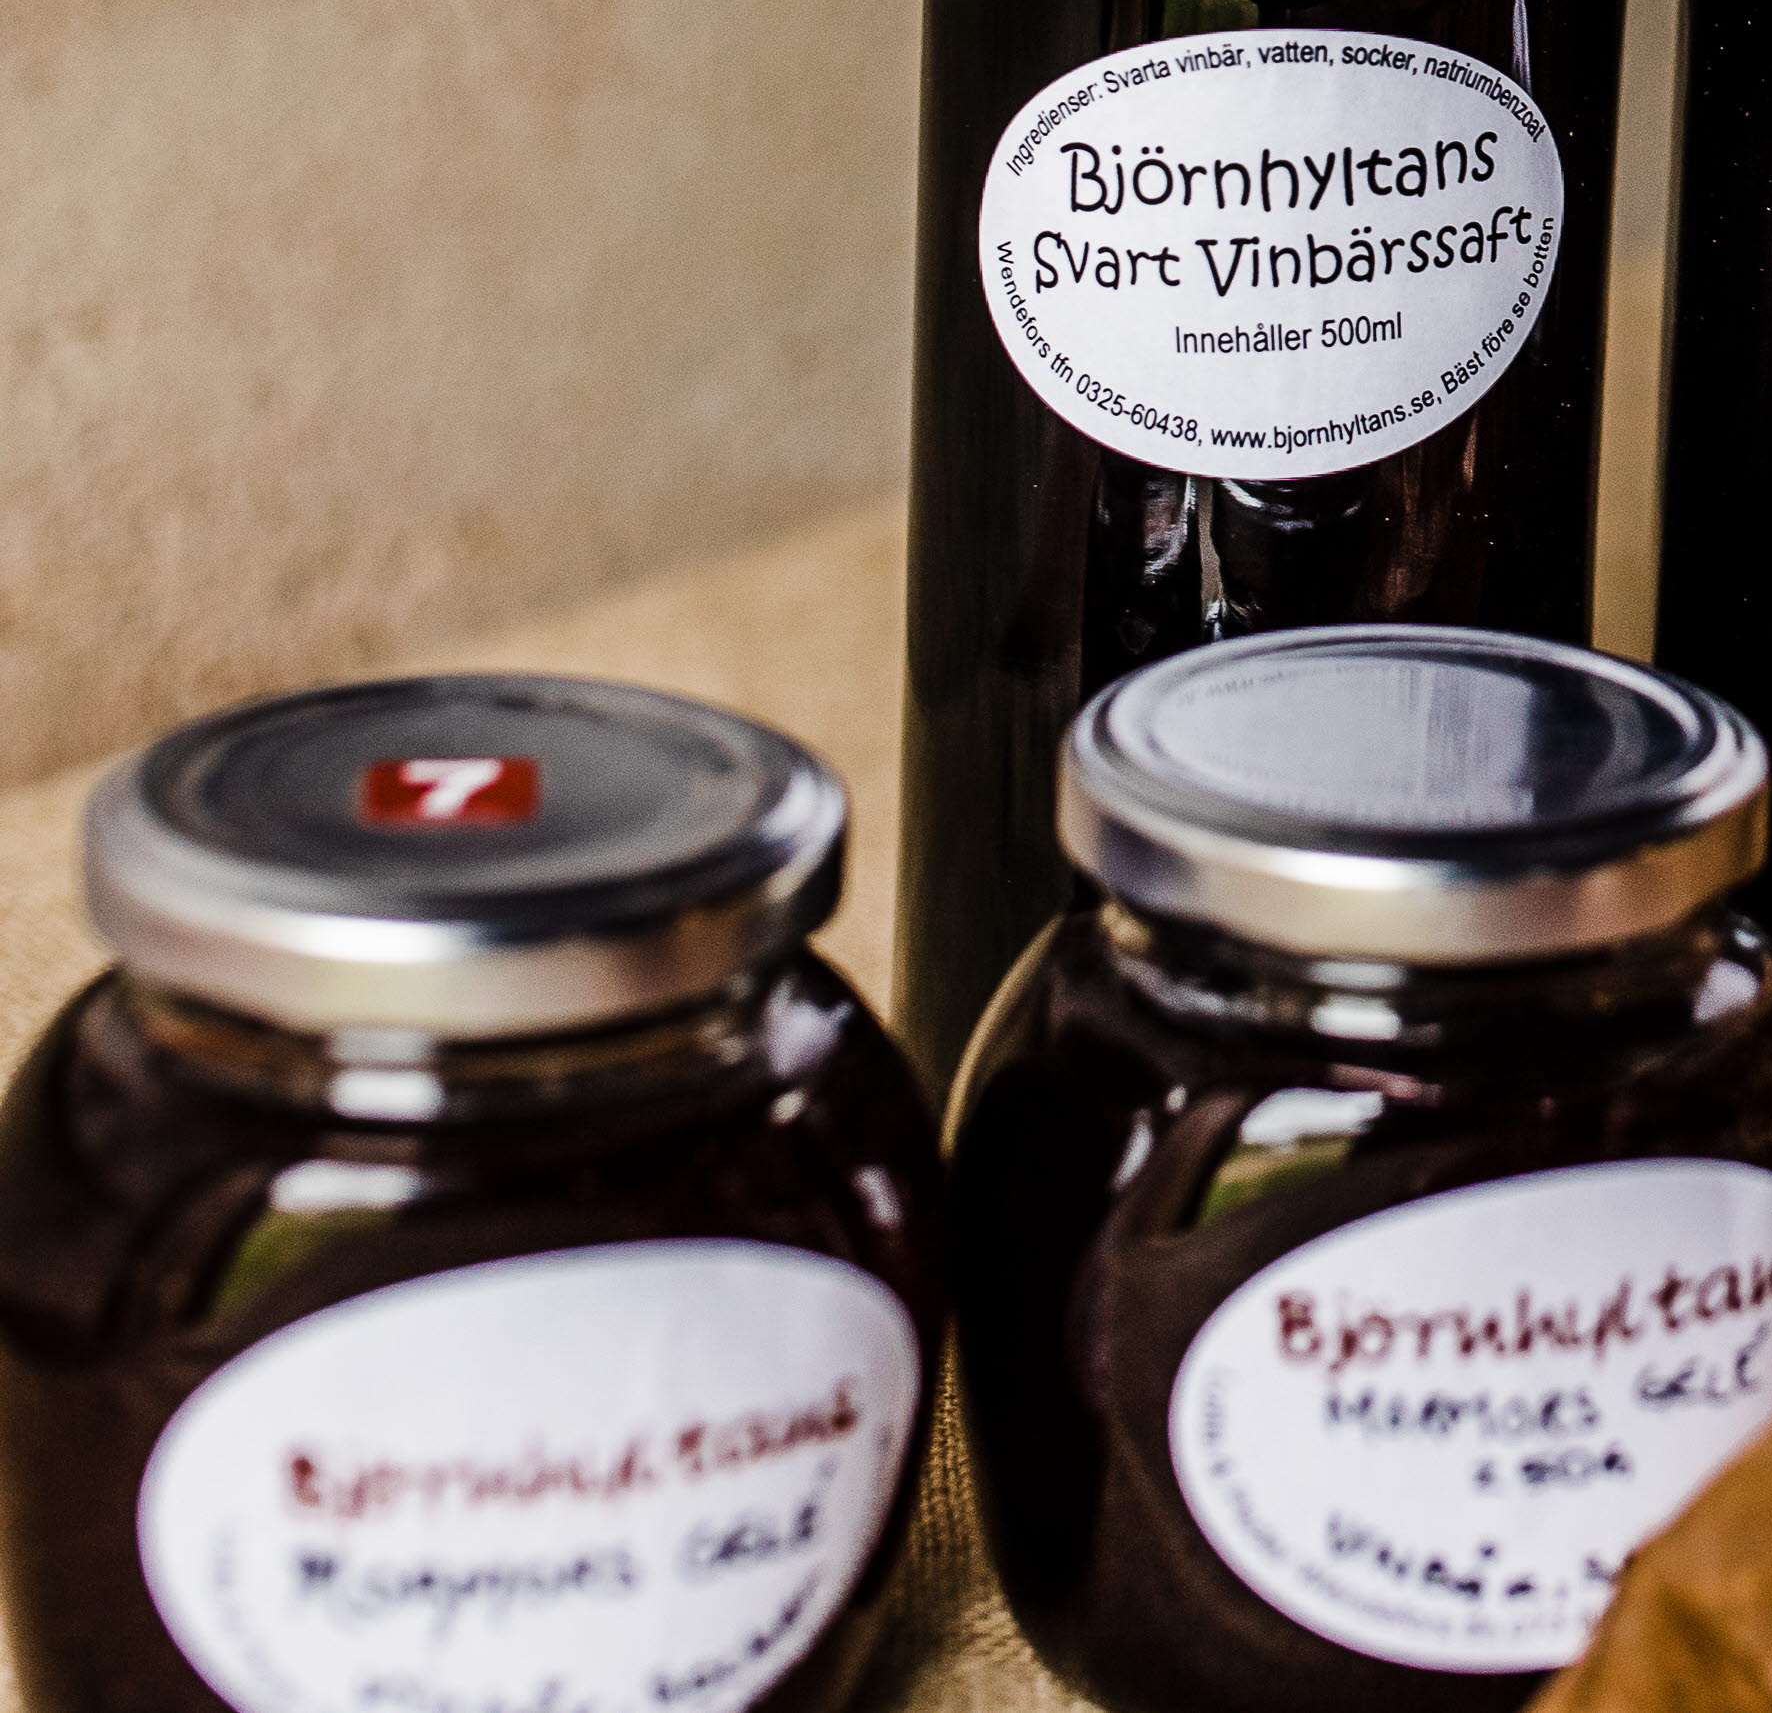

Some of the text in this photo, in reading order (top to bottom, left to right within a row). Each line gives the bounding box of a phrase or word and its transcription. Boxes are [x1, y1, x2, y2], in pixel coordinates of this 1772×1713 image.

[1006, 42, 1546, 176] Ingredienser: Svarta vinbär, vatten, socker, natriumbenzoat
[1060, 131, 1499, 215] Björnhyltans
[1033, 205, 1532, 298] Svart Vinbärssaft
[997, 217, 1555, 454] Wendefors tfn 0325-60438, www.bjornhyltans.se, Bäst före se botten
[1175, 311, 1402, 354] Innehåller 500ml
